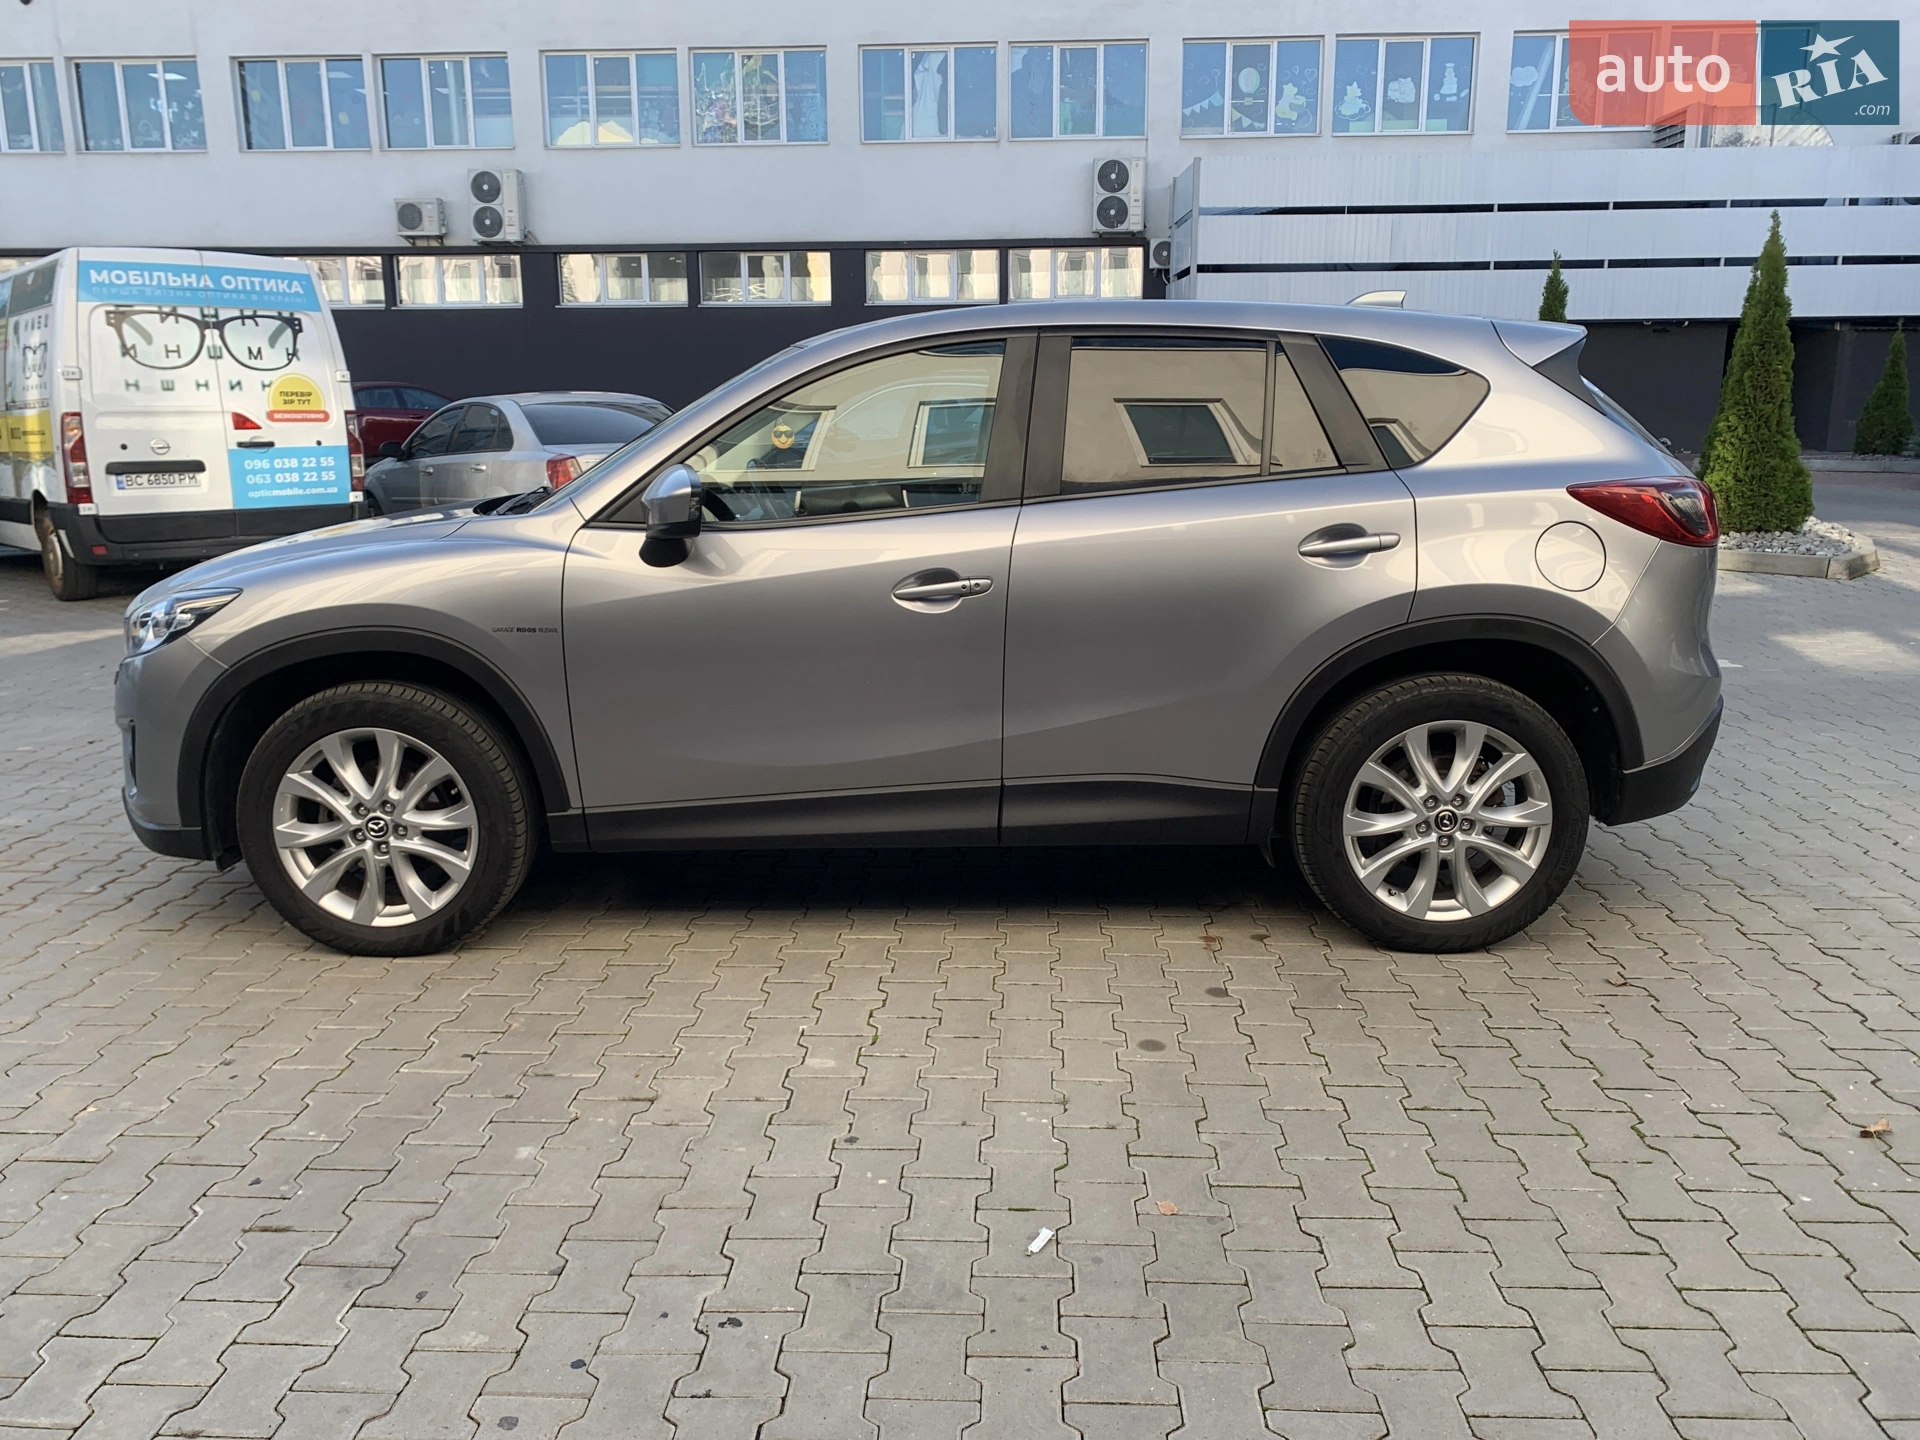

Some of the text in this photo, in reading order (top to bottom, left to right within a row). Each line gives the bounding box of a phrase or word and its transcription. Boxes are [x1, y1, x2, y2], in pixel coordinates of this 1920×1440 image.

[89, 269, 304, 294] МОБІЛЬНА ОПТИКА
[164, 343, 182, 359] Н
[206, 344, 223, 359] Ш
[247, 346, 263, 361] М
[244, 456, 335, 470] 096 038 22 55
[147, 473, 176, 485] 6850
[246, 471, 336, 484] 063 038 22 55
[248, 486, 338, 499] opticmobile.com.ua
